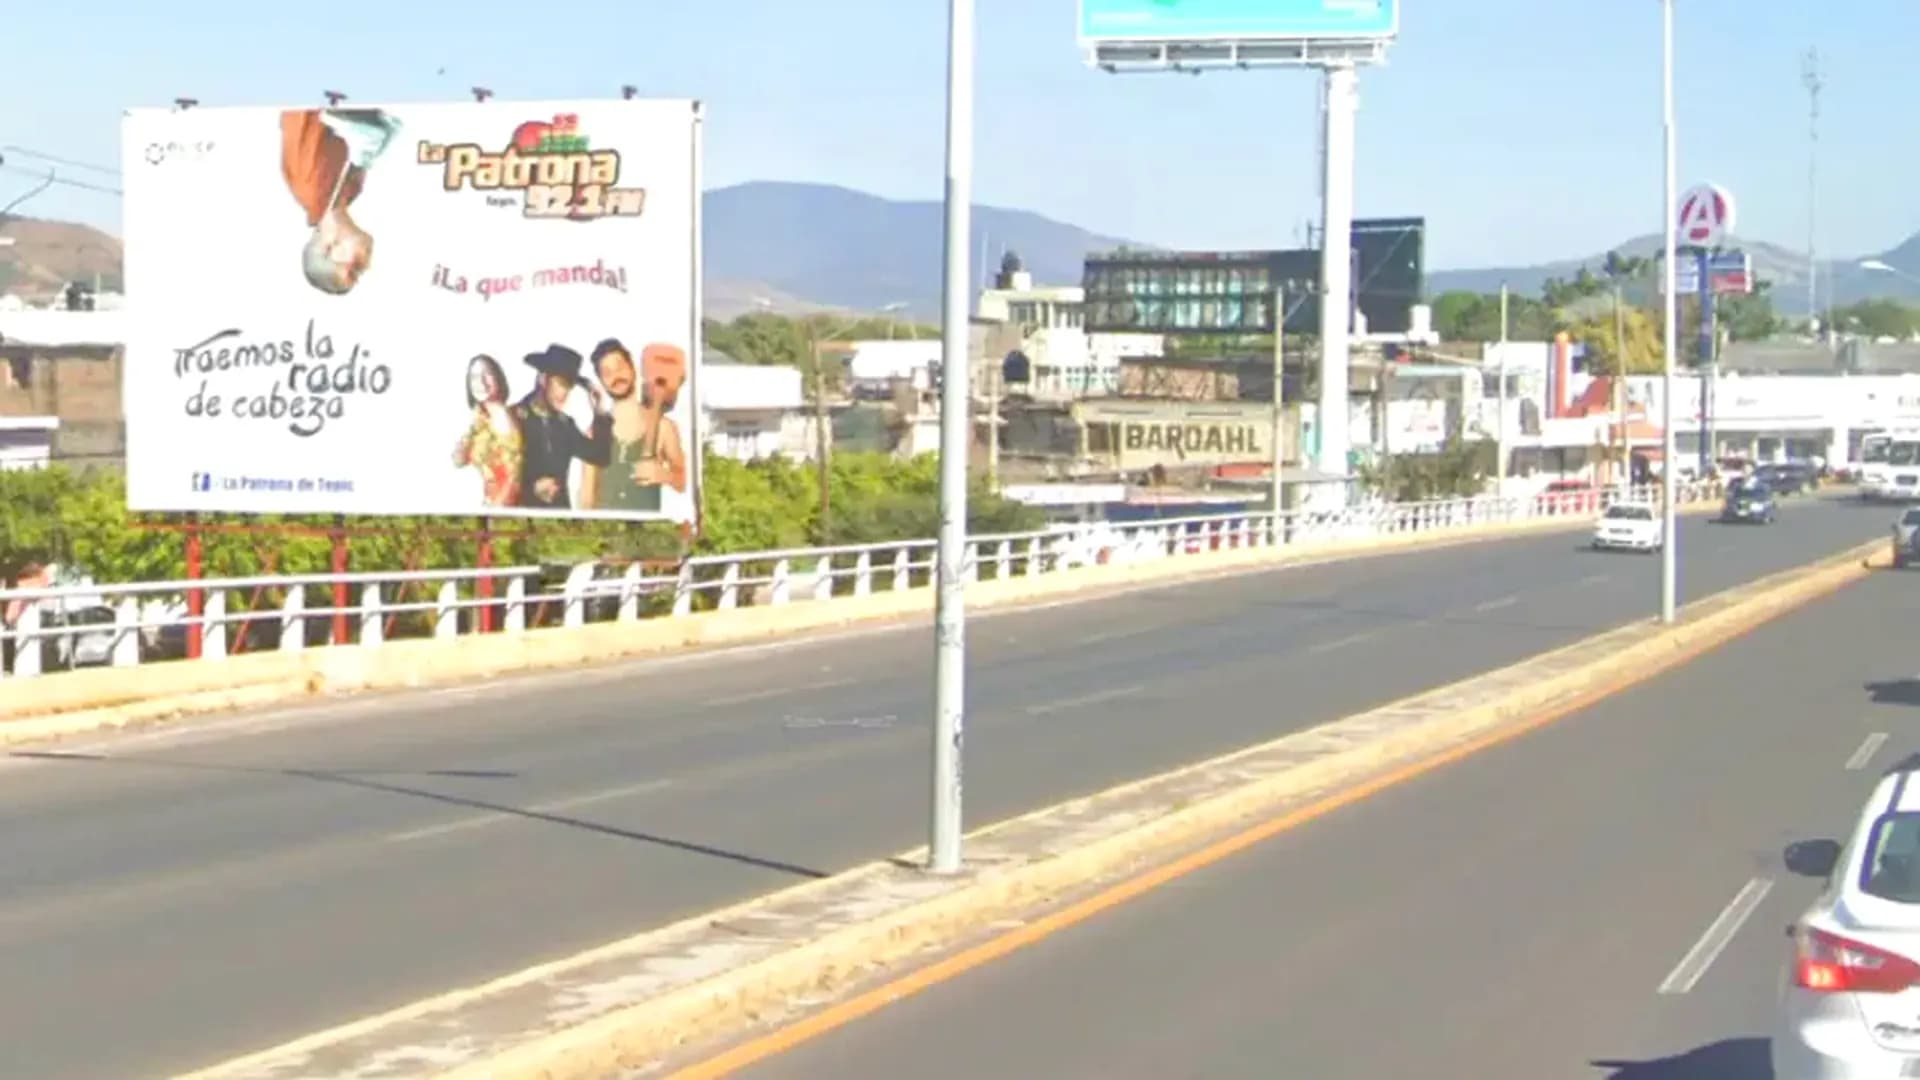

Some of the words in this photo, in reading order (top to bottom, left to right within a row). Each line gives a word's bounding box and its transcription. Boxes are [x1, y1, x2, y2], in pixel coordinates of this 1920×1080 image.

[418, 141, 446, 163] La
[444, 144, 620, 190] Patrona
[1679, 189, 1728, 246] A
[431, 263, 469, 294] ¡La
[475, 272, 524, 303] que
[531, 258, 629, 294] manda!
[173, 328, 294, 378] Traemos
[305, 317, 335, 359] la
[287, 343, 392, 394] radio
[185, 379, 221, 417] de
[231, 381, 345, 437] cabeza
[1125, 422, 1262, 459] BARDAHL
[241, 476, 294, 491] Patrona
[297, 477, 314, 492] de
